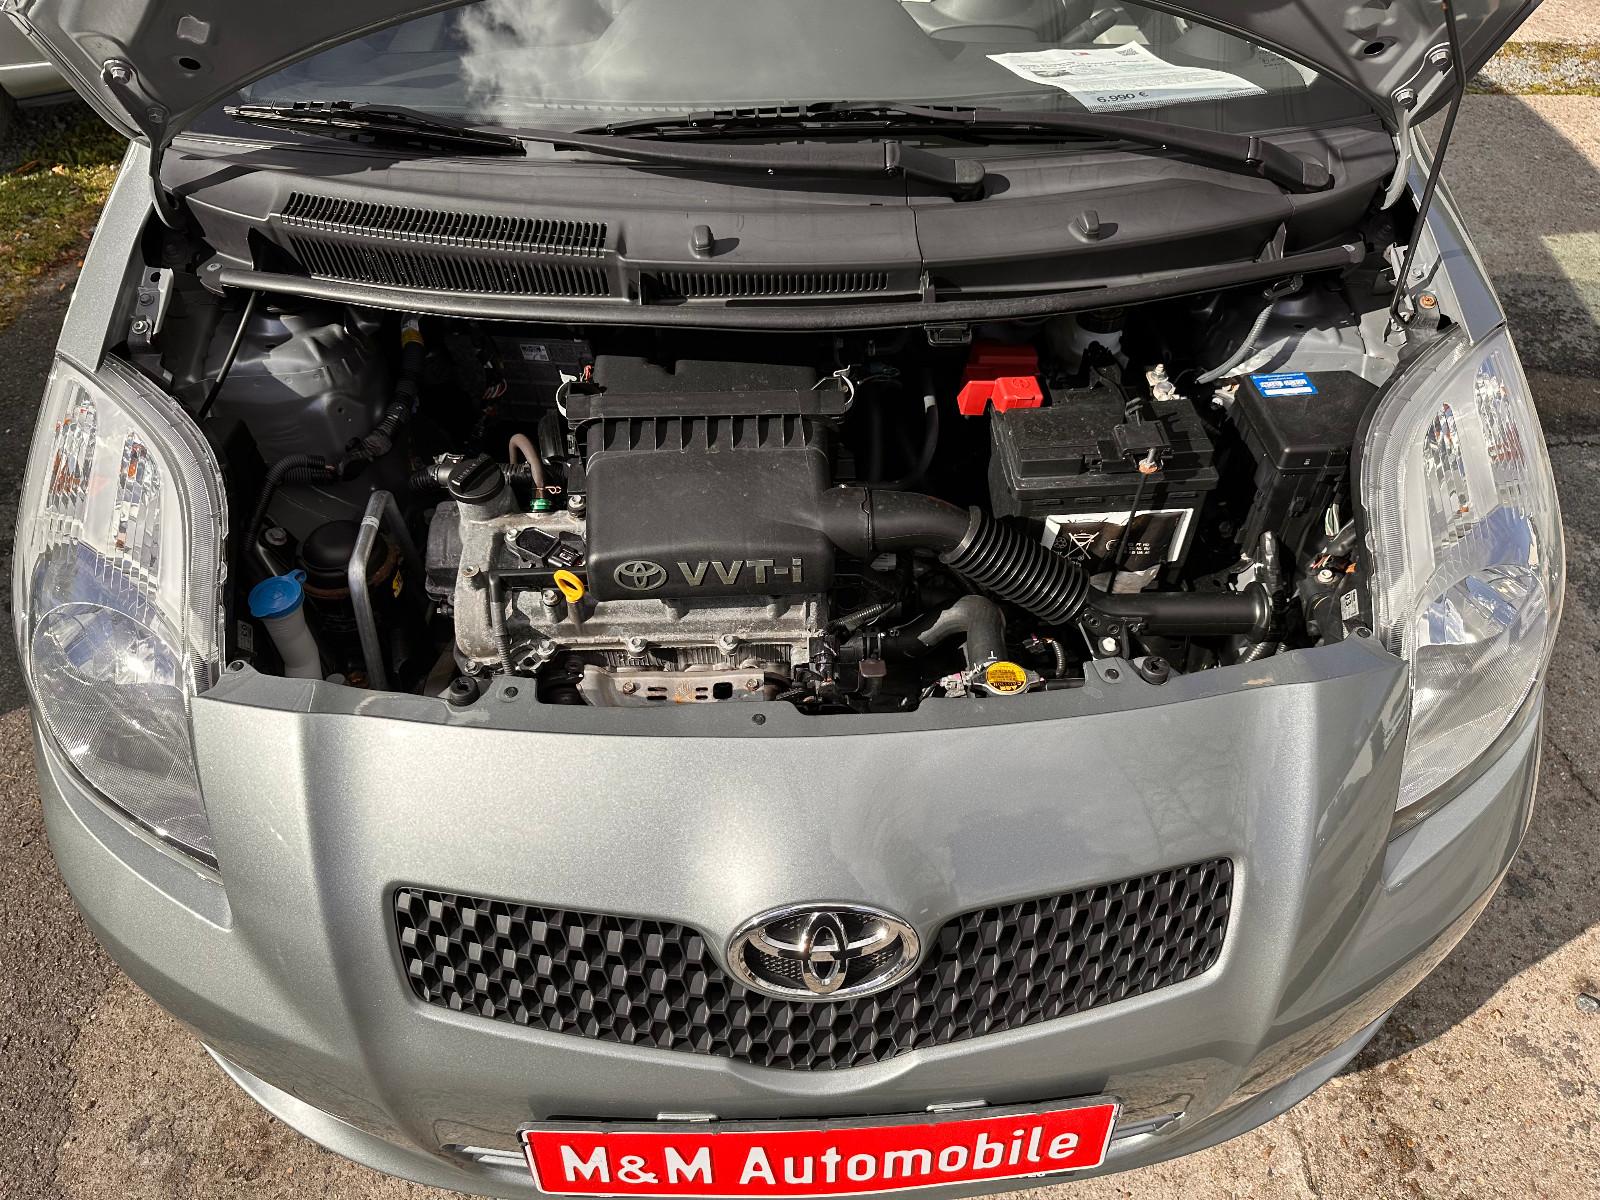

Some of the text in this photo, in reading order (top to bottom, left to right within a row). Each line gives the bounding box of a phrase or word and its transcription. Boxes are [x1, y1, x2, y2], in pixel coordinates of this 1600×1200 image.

[1096, 93, 1136, 103] 6.990
[677, 558, 802, 586] VVT-i
[560, 1125, 1079, 1185] M&M Automobile
